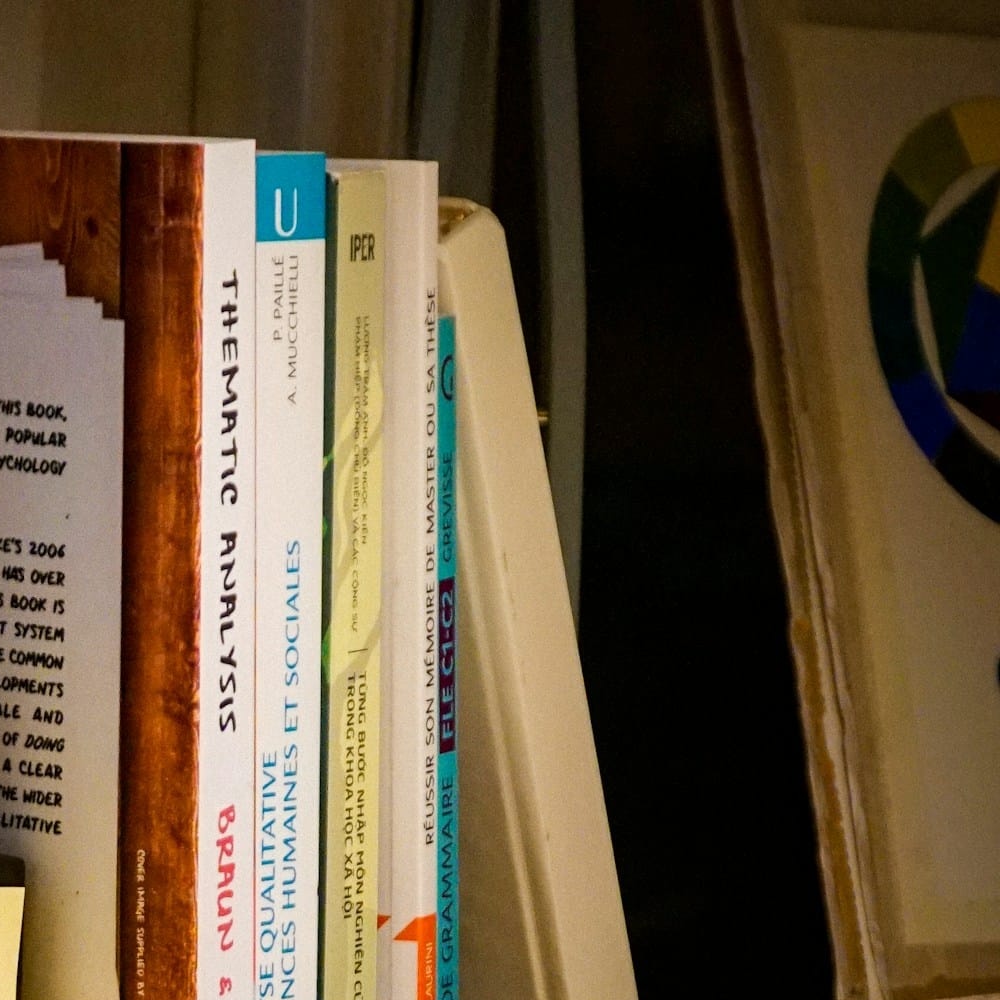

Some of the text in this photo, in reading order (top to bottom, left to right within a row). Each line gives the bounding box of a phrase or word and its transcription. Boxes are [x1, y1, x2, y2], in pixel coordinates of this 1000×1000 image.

[274, 187, 297, 238] U
[350, 233, 375, 262] IPER
[271, 255, 284, 319] PAILLÉ
[287, 255, 299, 378] MUCCHIELLI
[26, 402, 67, 422] BOOK,
[5, 427, 67, 448] POPULAR
[219, 269, 239, 732] THEMATIC ANALYSIS
[442, 452, 453, 562] GREVISSE
[29, 541, 66, 559] 2006
[423, 287, 437, 846] RÉUSSIR SON MÉMOIRE DE MASTER OU SA THÈSE
[2, 565, 25, 583] HAS
[30, 568, 66, 587] OVER
[10, 595, 47, 613] BOOK
[53, 600, 65, 615] IS
[284, 540, 301, 687] SOCIALES
[14, 622, 65, 642] SYSTEM
[9, 649, 65, 671] COMMON
[440, 591, 455, 741] FLE C1-C2
[32, 706, 64, 726] AND
[283, 696, 299, 733] ET
[345, 672, 357, 740] TRONG
[2, 731, 19, 747] OF
[24, 733, 65, 753] DOING
[2, 757, 12, 772] A
[19, 760, 63, 780] CLEAR
[344, 746, 355, 801] KHOA
[22, 791, 63, 808] WIDER
[280, 743, 299, 910] HUMAINES
[342, 807, 354, 849] HỌC
[136, 849, 146, 882] COVER
[258, 750, 278, 953] QUALITATIVE
[440, 775, 453, 963] GRAMMAIRE
[216, 805, 236, 951] BRAUN
[135, 887, 145, 921] IMAGE
[136, 927, 146, 977] SUPPLIED
[136, 981, 146, 997] BY
[219, 977, 233, 996] &
